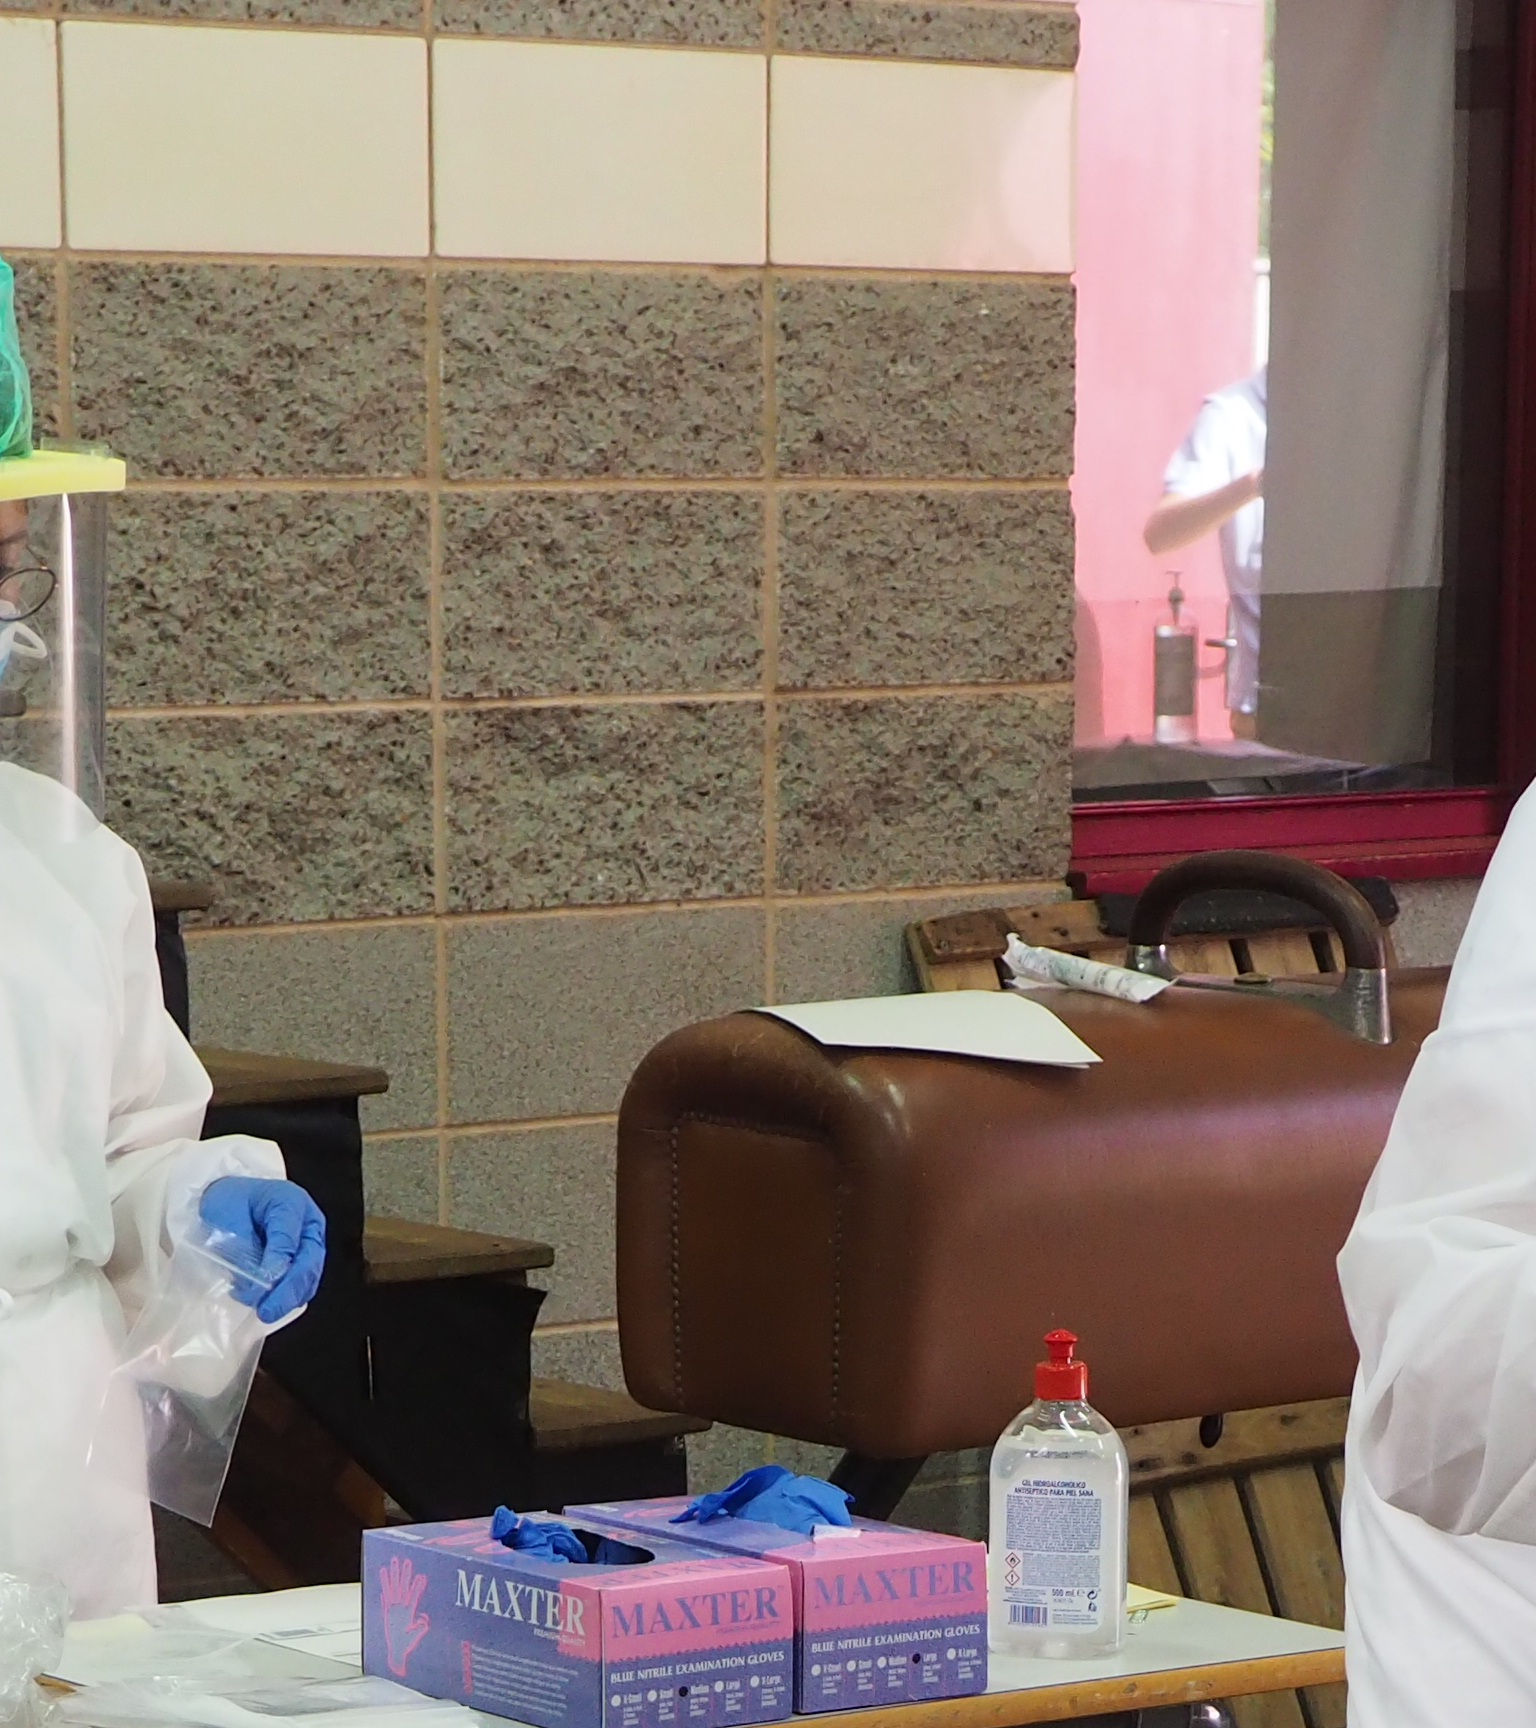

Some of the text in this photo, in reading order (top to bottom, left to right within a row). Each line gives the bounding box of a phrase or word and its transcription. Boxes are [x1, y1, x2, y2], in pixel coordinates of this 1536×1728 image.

[455, 1569, 586, 1637] MAXTER
[815, 1561, 975, 1609] MAXTER
[611, 1586, 780, 1640] MAXTER
[811, 1623, 980, 1653] BLUE NITRILE EXAMINATION GLOVES
[610, 1650, 785, 1684] BLUE NITRILE EXAMINATION GLOVES
